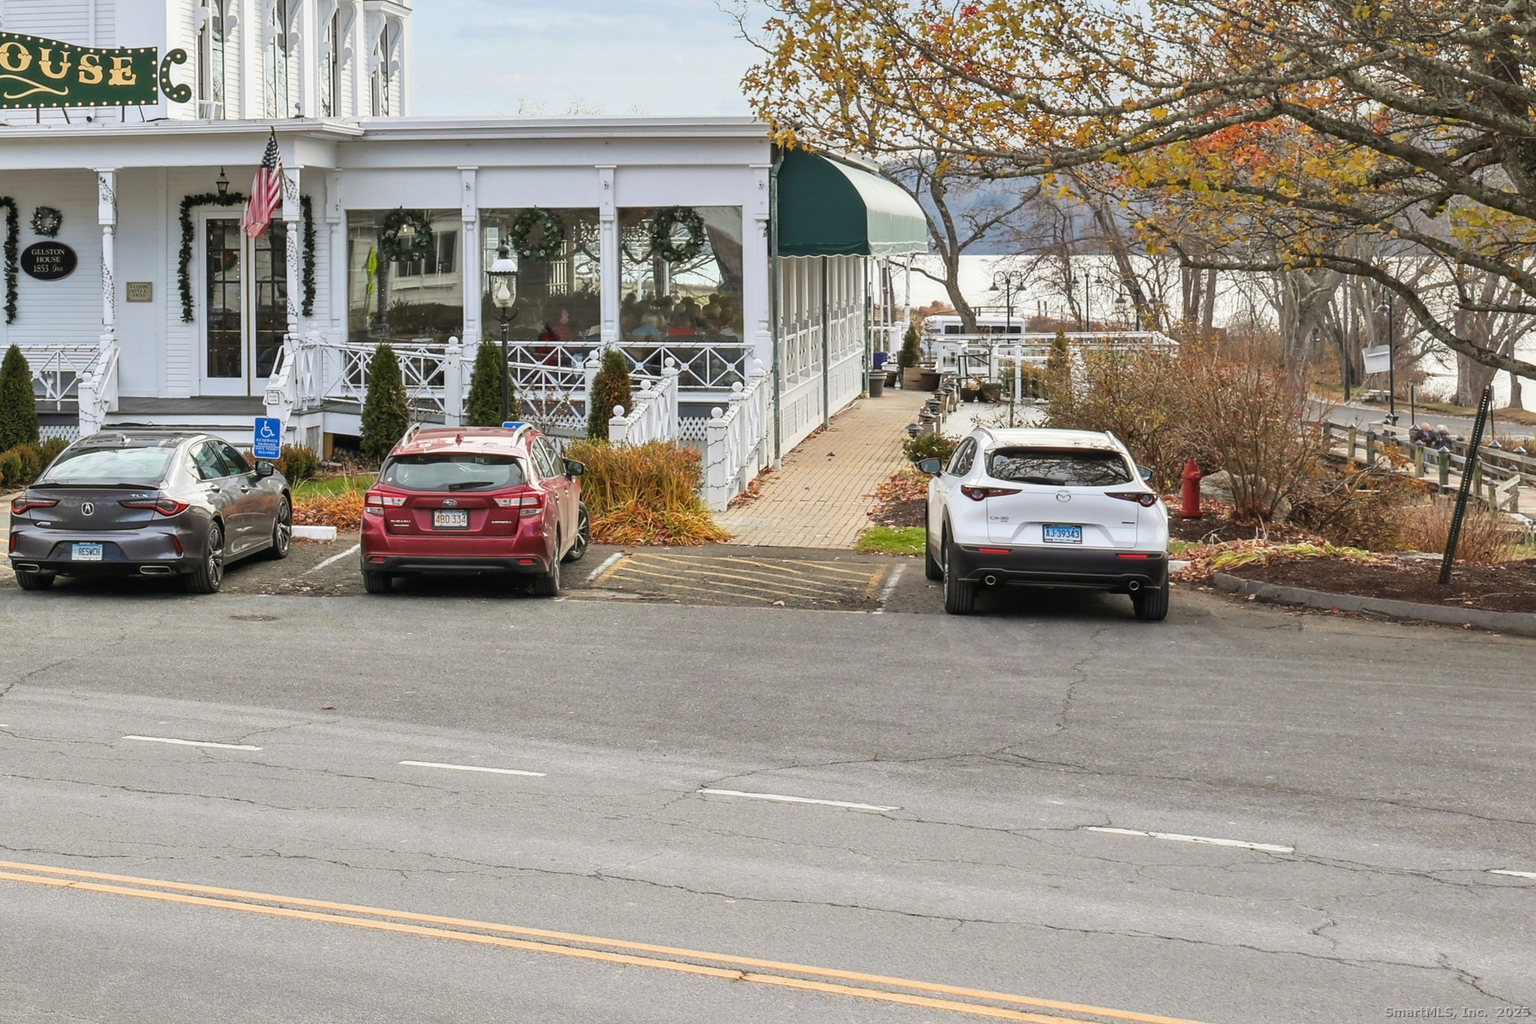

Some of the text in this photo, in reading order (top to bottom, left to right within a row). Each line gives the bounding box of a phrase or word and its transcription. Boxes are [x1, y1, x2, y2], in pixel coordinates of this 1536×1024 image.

[31, 248, 66, 256] GELSTON
[33, 264, 49, 273] 1853
[451, 514, 467, 525] 334
